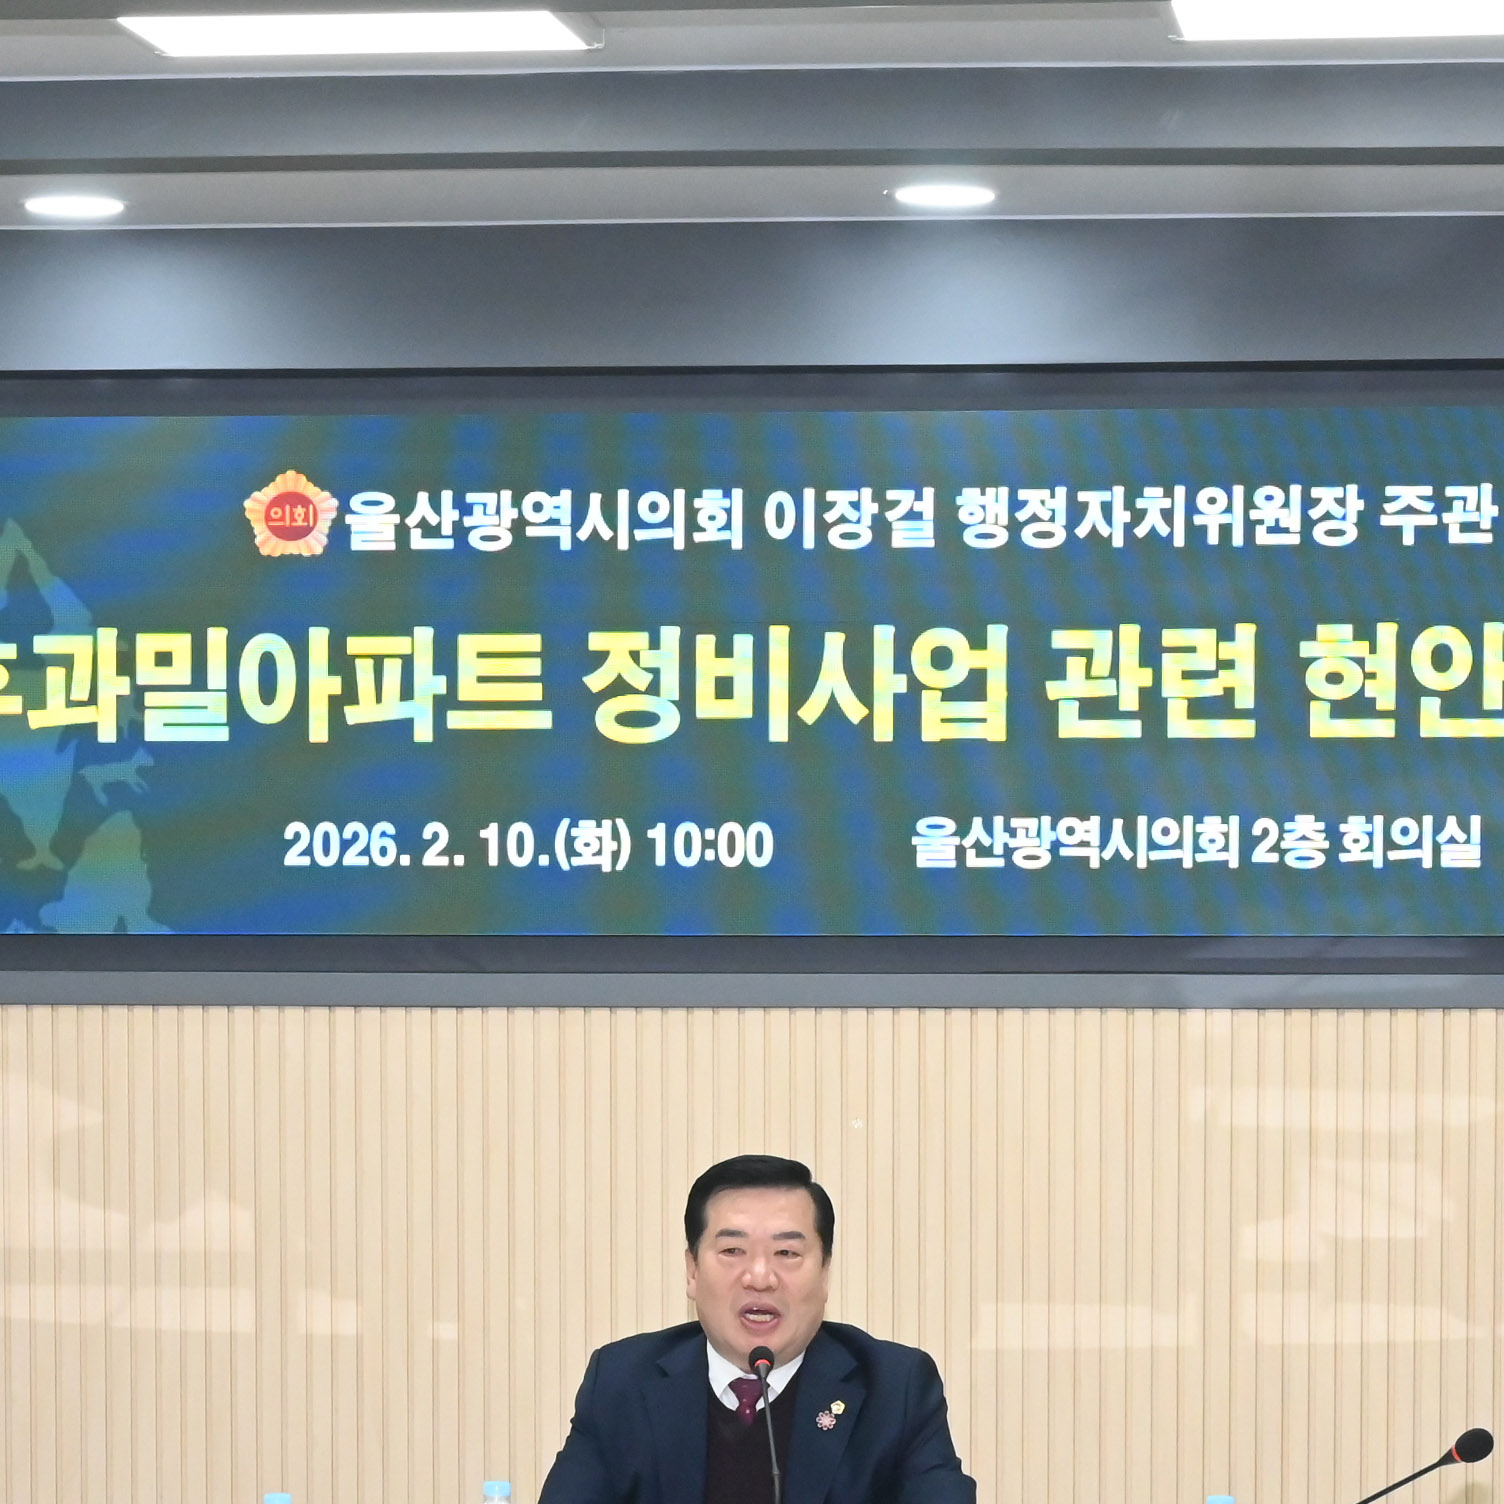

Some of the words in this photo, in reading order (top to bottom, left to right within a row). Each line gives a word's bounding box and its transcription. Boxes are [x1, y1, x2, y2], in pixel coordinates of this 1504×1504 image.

[267, 503, 314, 527] 의회
[344, 489, 743, 552] 울산광역시의회
[764, 488, 936, 550] 이장걸
[956, 485, 1365, 549] 행정자치위원장
[1380, 483, 1499, 546] 주관
[583, 624, 1009, 744] 정비사업
[1045, 622, 1257, 739] 관련
[283, 821, 410, 867] 2026.
[422, 821, 466, 867] 2.
[479, 818, 631, 873] 10.(화)
[647, 821, 774, 868] 10:00
[911, 815, 1240, 870] 울산광역시의회
[1251, 814, 1330, 869] 2층
[1338, 814, 1481, 869] 회의실
